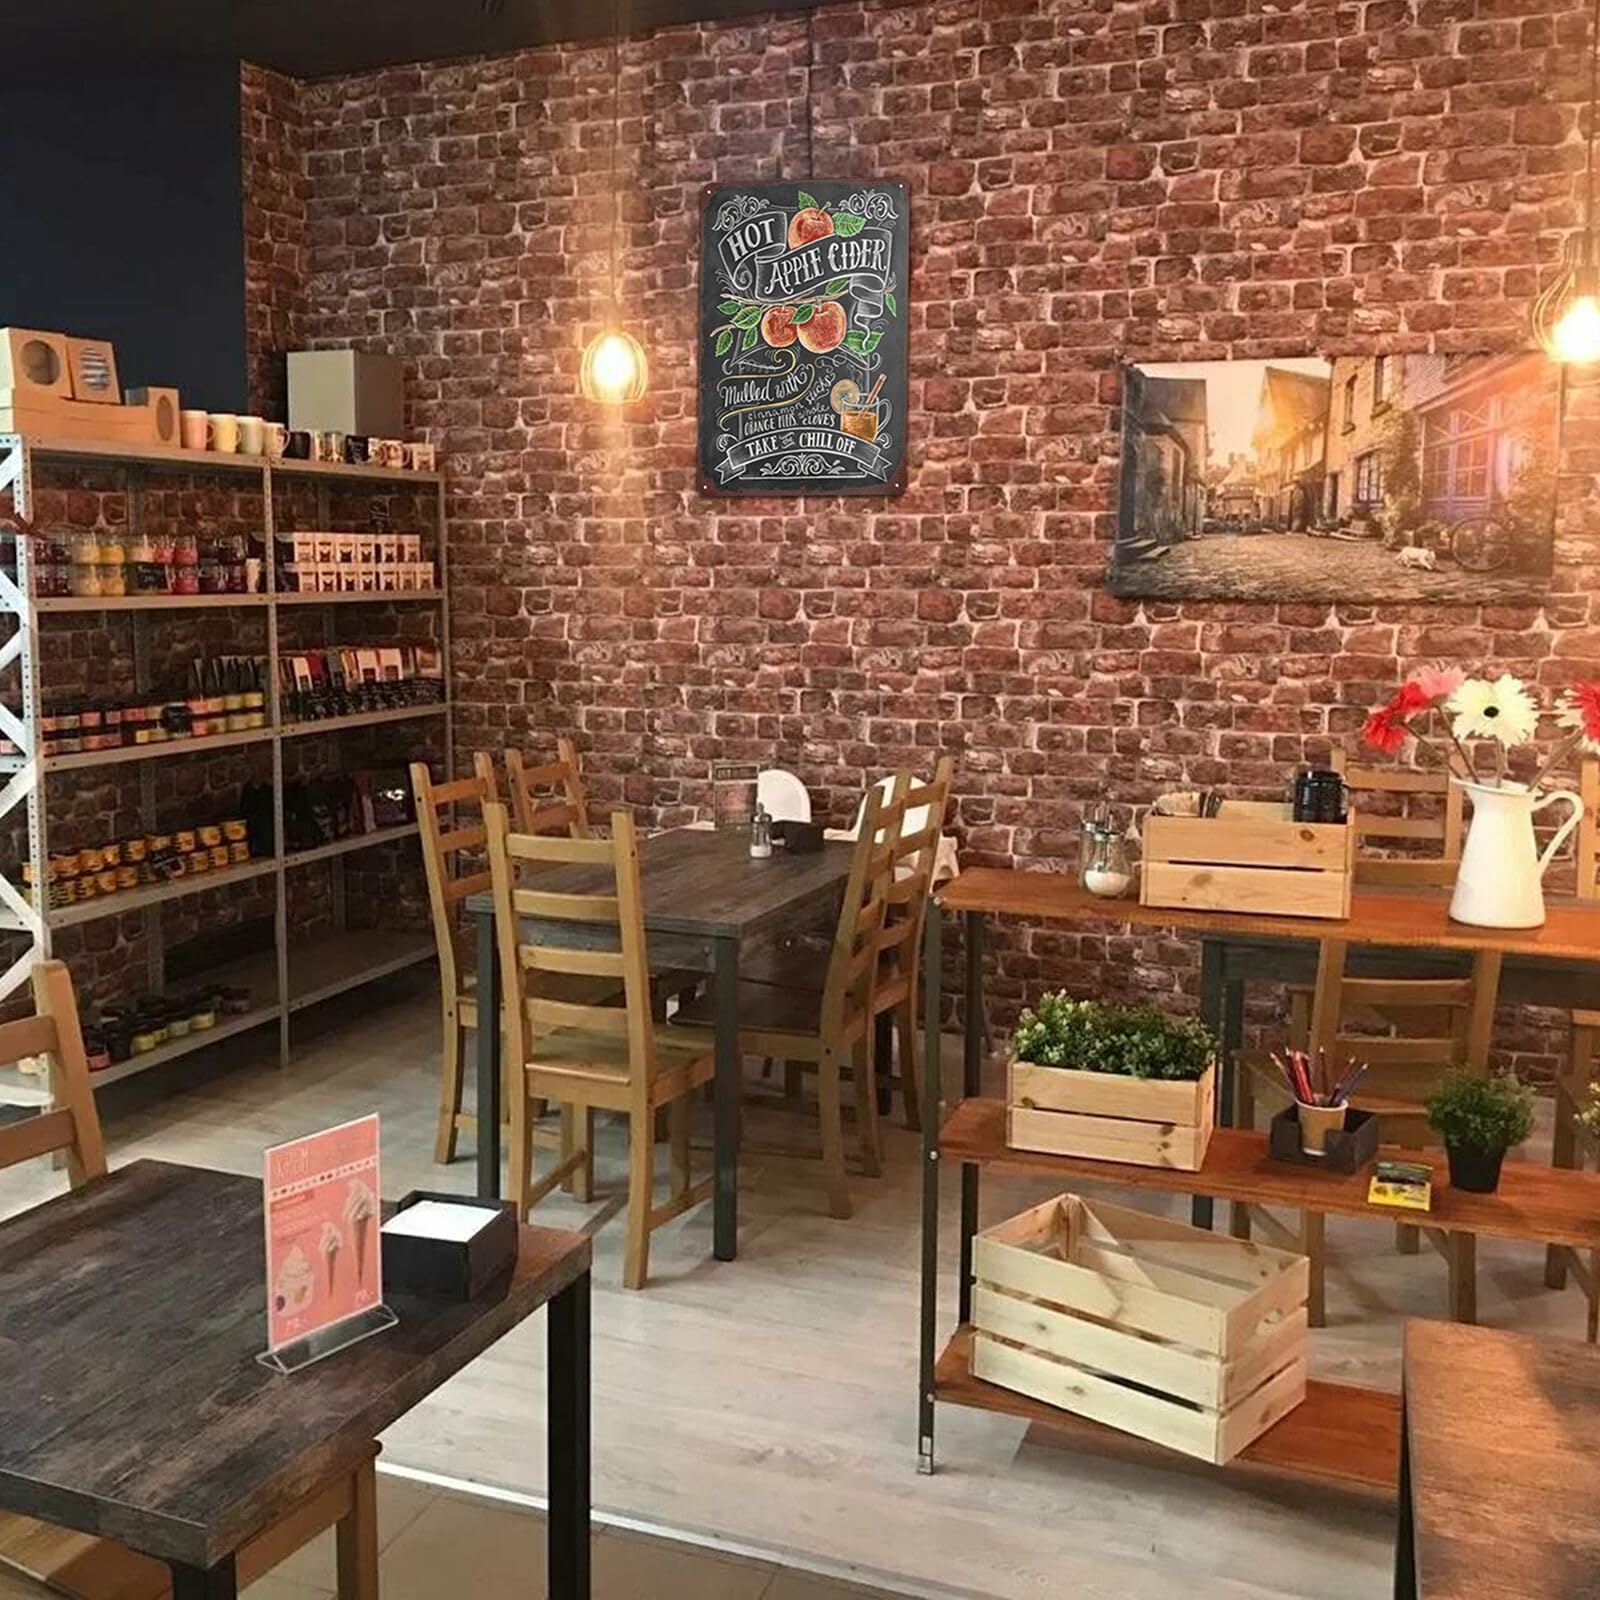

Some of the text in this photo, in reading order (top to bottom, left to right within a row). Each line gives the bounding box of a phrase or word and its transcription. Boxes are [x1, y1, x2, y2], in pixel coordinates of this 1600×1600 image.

[726, 217, 775, 262] HOT
[763, 238, 888, 295] APPLE CIDER
[720, 366, 808, 408] Mulled with
[748, 402, 804, 420] cinnamon
[744, 435, 779, 458] TAKE
[799, 431, 834, 450] CHILL
[835, 436, 857, 455] OFF
